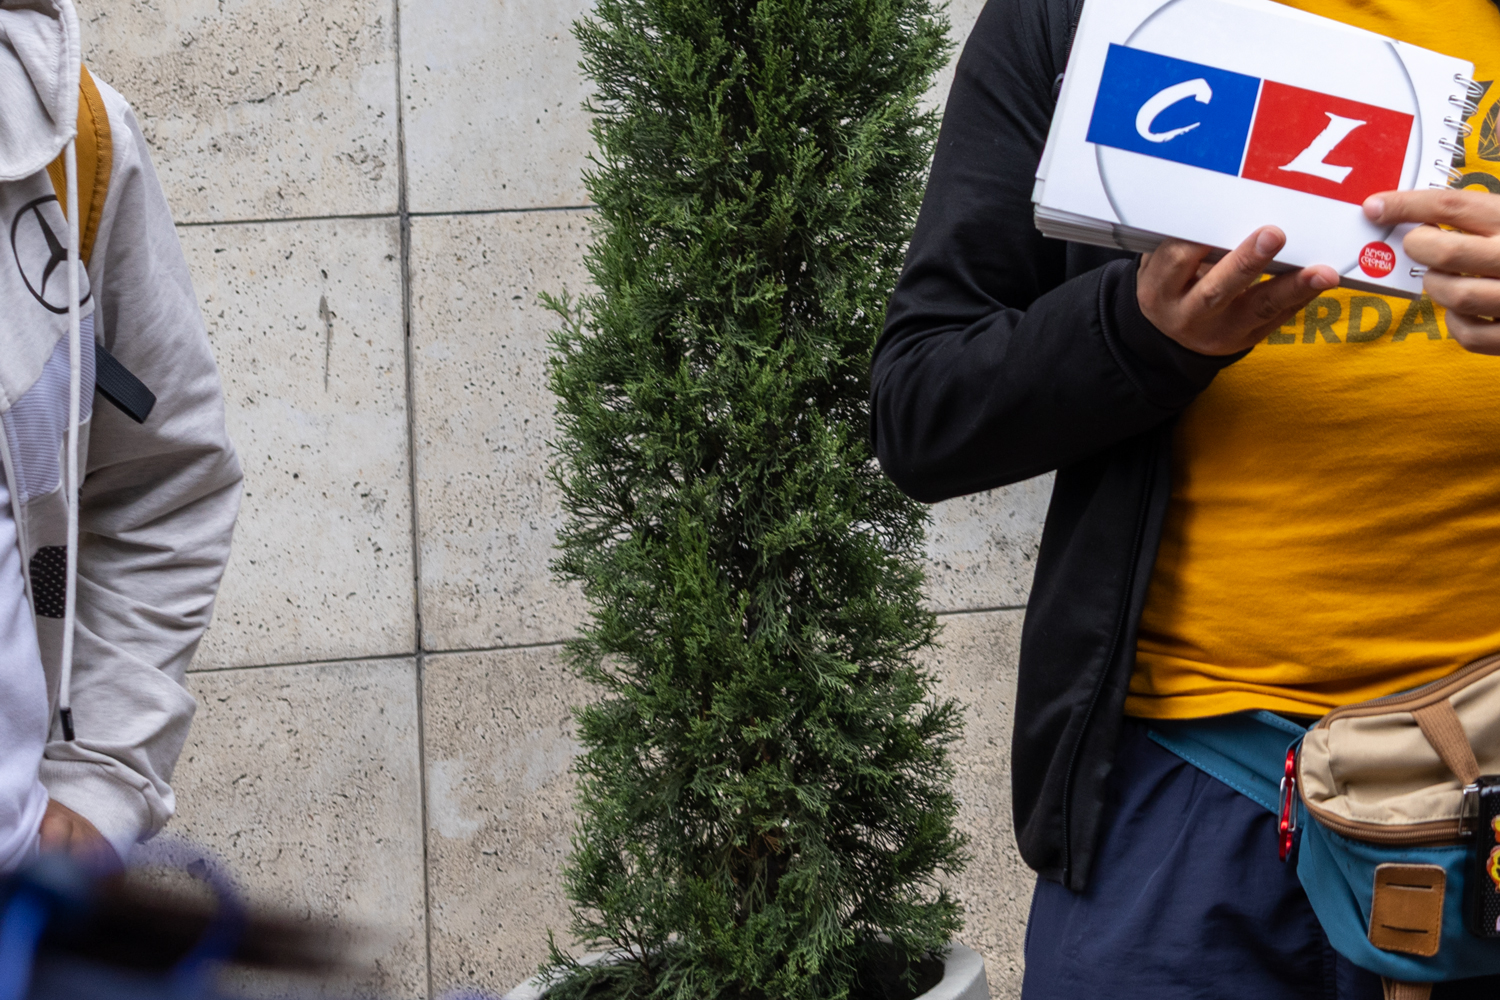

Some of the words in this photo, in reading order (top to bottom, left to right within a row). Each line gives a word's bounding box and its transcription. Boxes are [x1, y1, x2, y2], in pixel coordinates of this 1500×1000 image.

[1135, 78, 1213, 143] C
[1278, 111, 1367, 184] L
[1365, 247, 1392, 261] BEYOND
[1361, 255, 1392, 271] COLOMBIA
